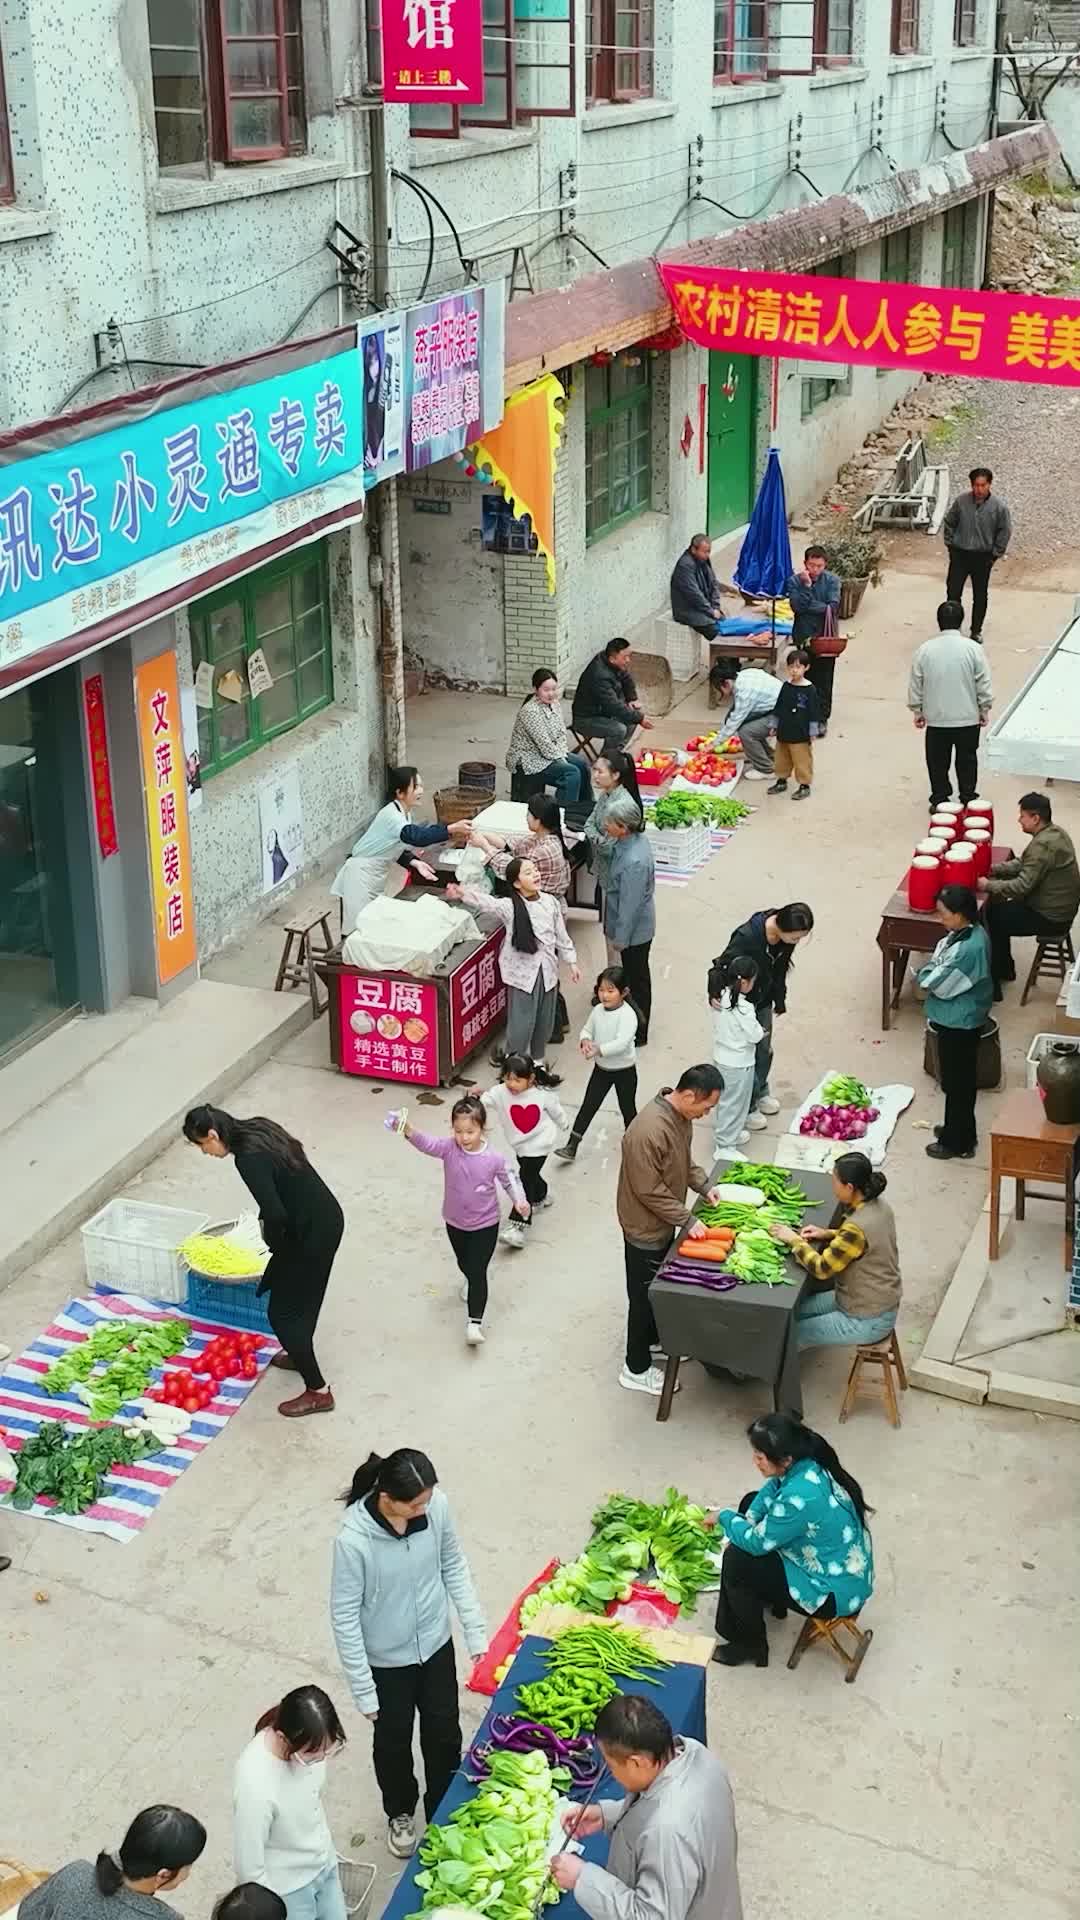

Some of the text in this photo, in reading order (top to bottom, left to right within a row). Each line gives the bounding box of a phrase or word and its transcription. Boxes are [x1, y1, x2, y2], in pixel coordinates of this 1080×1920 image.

[402, 0, 455, 48] 馆
[672, 279, 985, 360] 农村清洁人人参与
[151, 690, 184, 940] 文萍服装店
[354, 979, 424, 1015] 豆腐
[460, 951, 495, 1016] 豆腐
[353, 1038, 427, 1062] 精选黄豆
[354, 1054, 428, 1077] 手工制作
